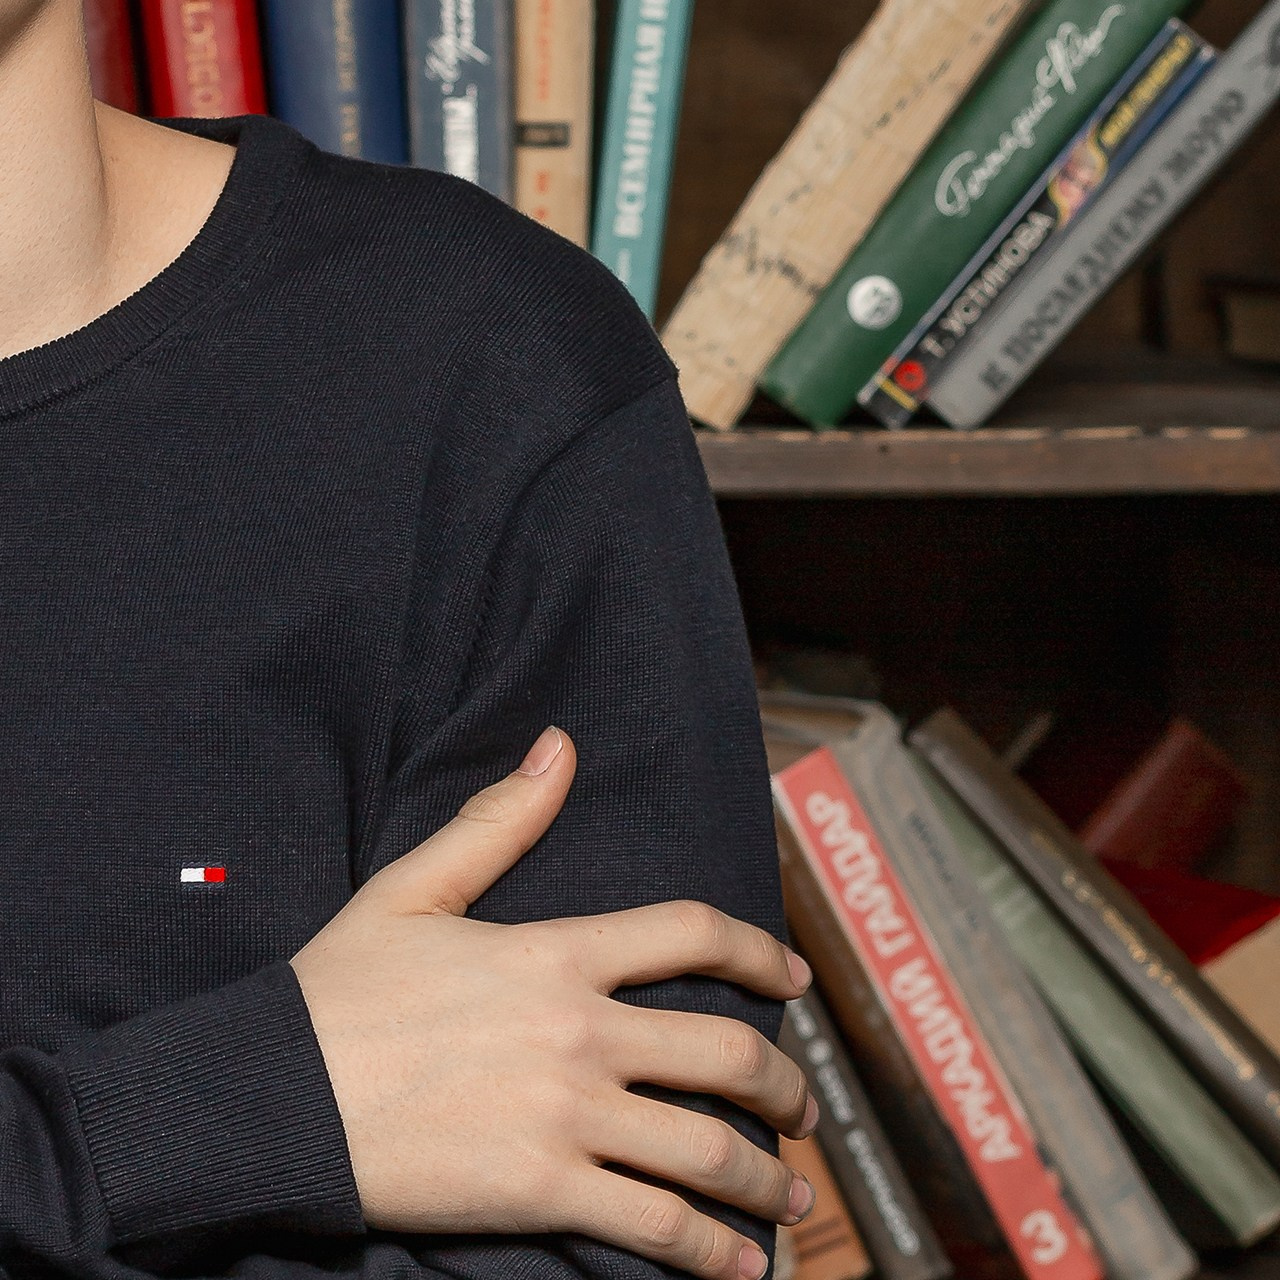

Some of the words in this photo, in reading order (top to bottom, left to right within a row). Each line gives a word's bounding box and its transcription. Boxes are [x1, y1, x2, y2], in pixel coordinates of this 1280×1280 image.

[607, 22, 670, 239] ВСЕМИРНАЯ
[937, 204, 1057, 343] УСТИНОВА
[972, 357, 1011, 395] К
[996, 170, 1175, 371] ПОСЛЕДНЕМУ
[791, 781, 921, 967] ГАЙДАР
[881, 954, 1028, 1174] АРКАДИЙ
